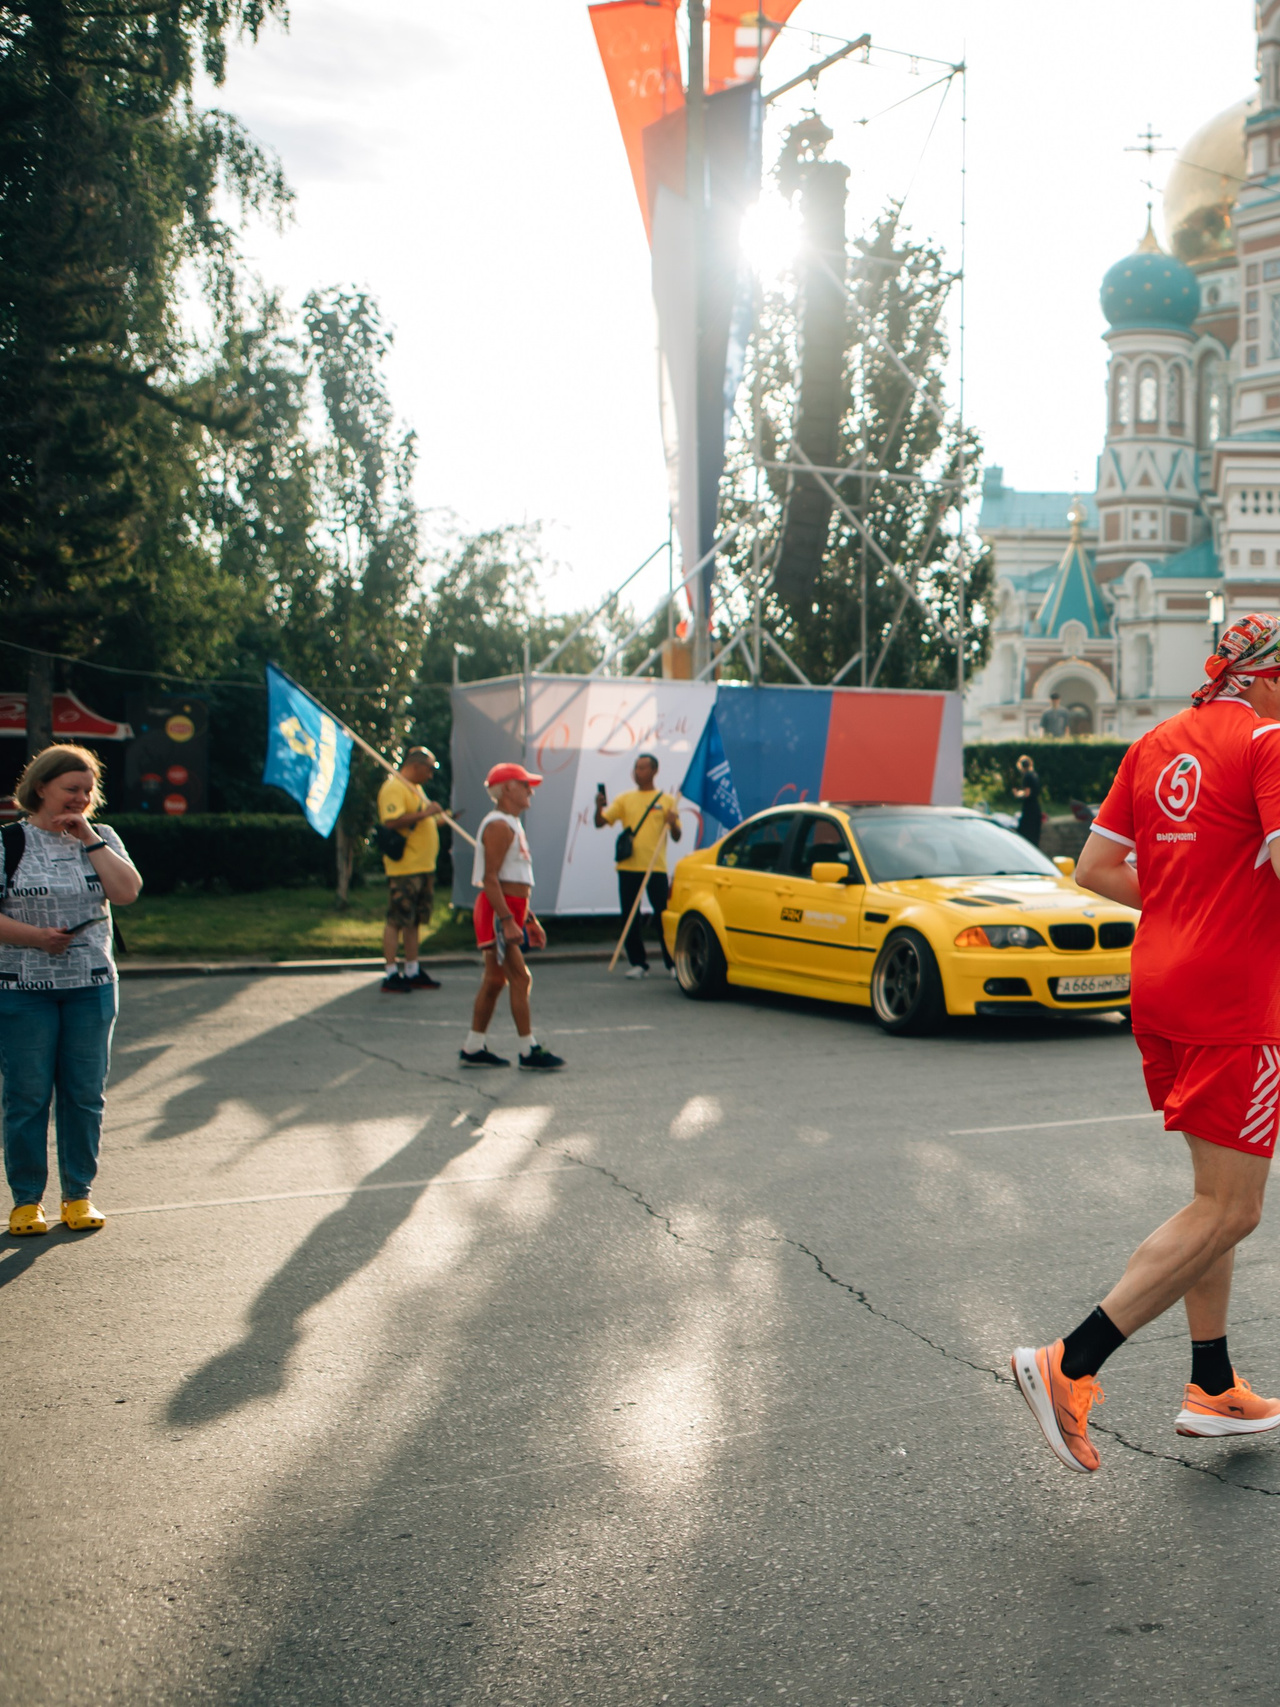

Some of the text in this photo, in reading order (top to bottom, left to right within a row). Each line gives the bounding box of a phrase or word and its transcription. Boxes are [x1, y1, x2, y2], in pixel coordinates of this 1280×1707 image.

[1156, 831, 1197, 843] выручает!
[12, 886, 48, 897] MOOD
[16, 980, 54, 990] MOOD
